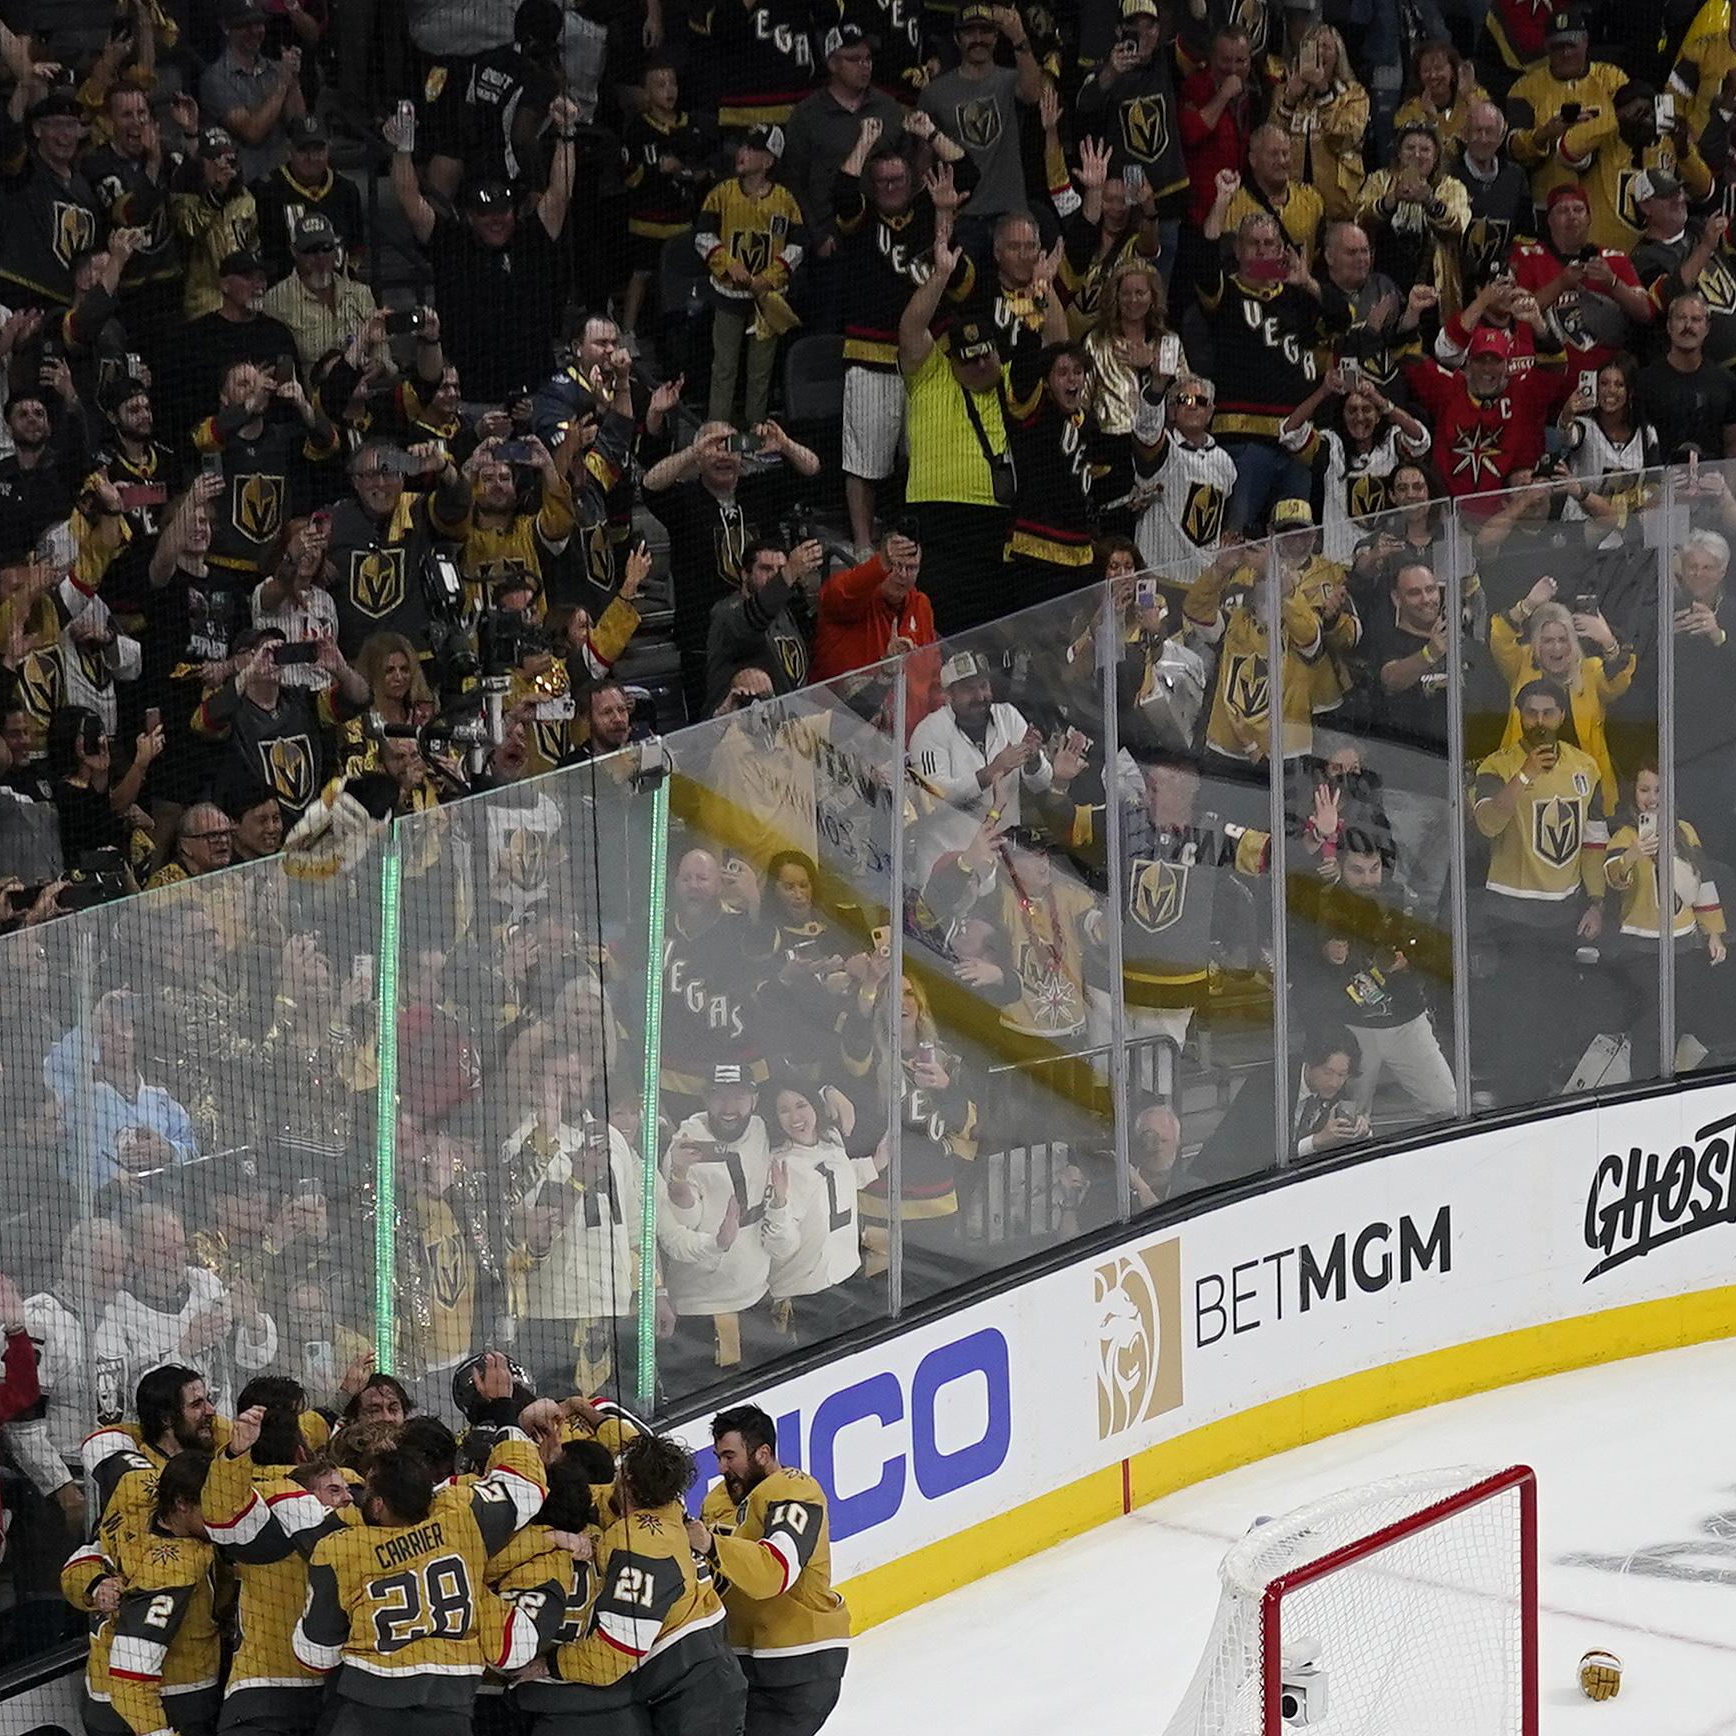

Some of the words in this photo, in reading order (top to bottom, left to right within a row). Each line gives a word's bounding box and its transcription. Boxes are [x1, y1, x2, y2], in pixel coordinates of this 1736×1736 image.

[1195, 1203, 1452, 1350] BETMGM
[771, 1502, 808, 1537] 10
[374, 1521, 445, 1571] CARRIER
[365, 1553, 475, 1656] 28
[612, 1566, 656, 1609] 21
[143, 1594, 175, 1629] 2
